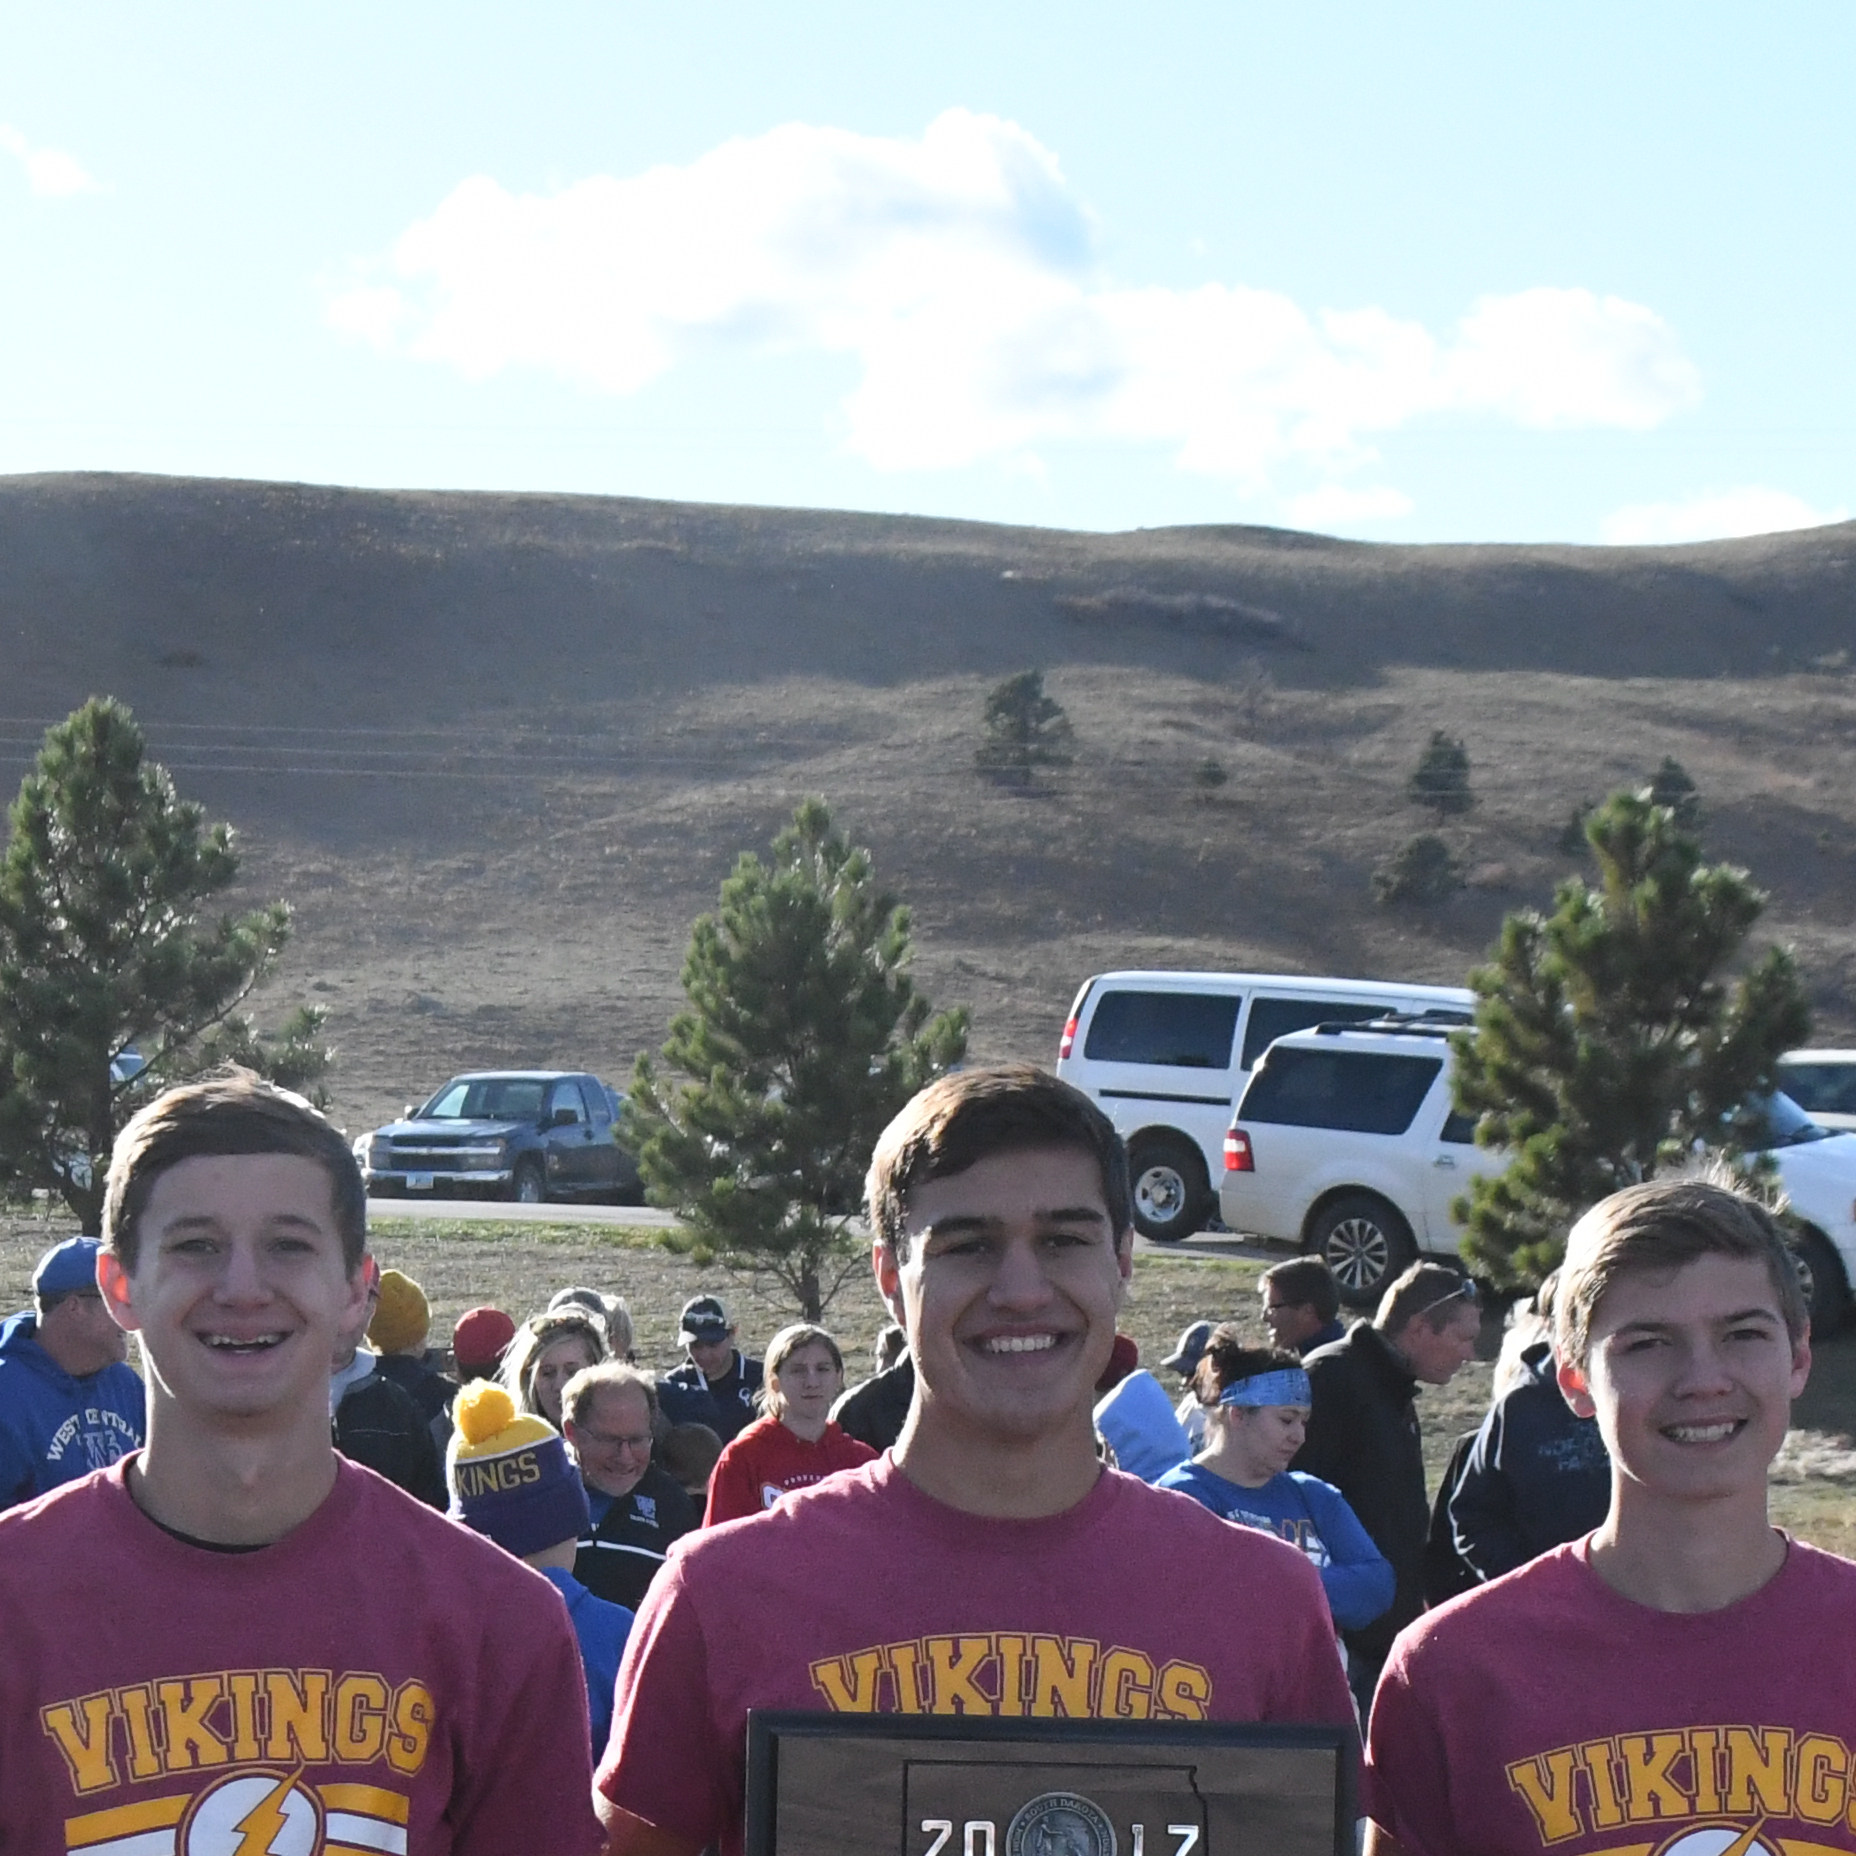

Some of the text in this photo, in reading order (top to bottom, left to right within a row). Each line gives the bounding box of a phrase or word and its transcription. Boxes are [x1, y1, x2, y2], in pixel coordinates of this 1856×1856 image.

[47, 1414, 81, 1460] WEST
[809, 1631, 1213, 1721] VIKINGS
[39, 1668, 436, 1797] VIKINGS
